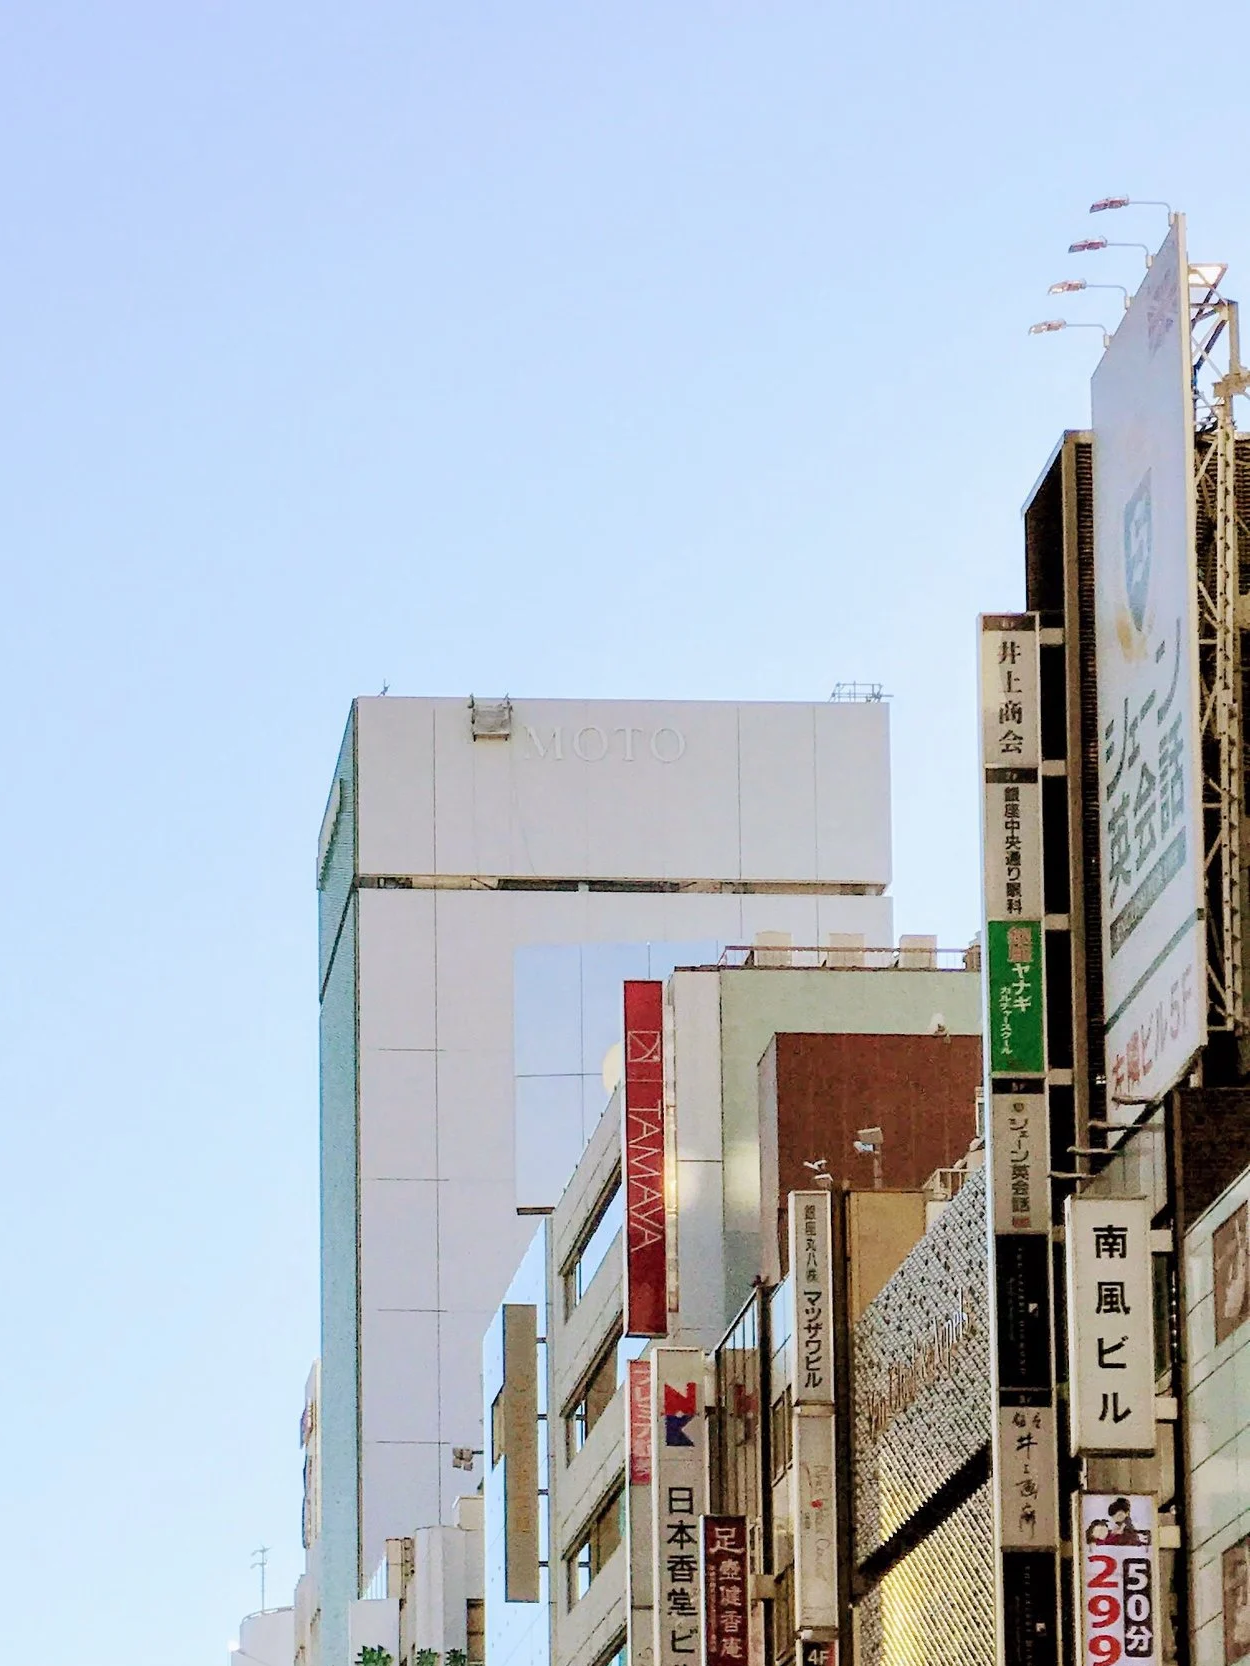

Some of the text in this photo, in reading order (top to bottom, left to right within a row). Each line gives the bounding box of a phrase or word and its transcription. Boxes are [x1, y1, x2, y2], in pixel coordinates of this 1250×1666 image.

[524, 725, 687, 764] MOTO
[997, 640, 1024, 755] 井上商会
[627, 1100, 663, 1253] TAMAYA
[803, 1289, 823, 1390] マツザワビル
[1092, 1225, 1132, 1424] 南風ビル
[807, 1650, 830, 1665] 4F
